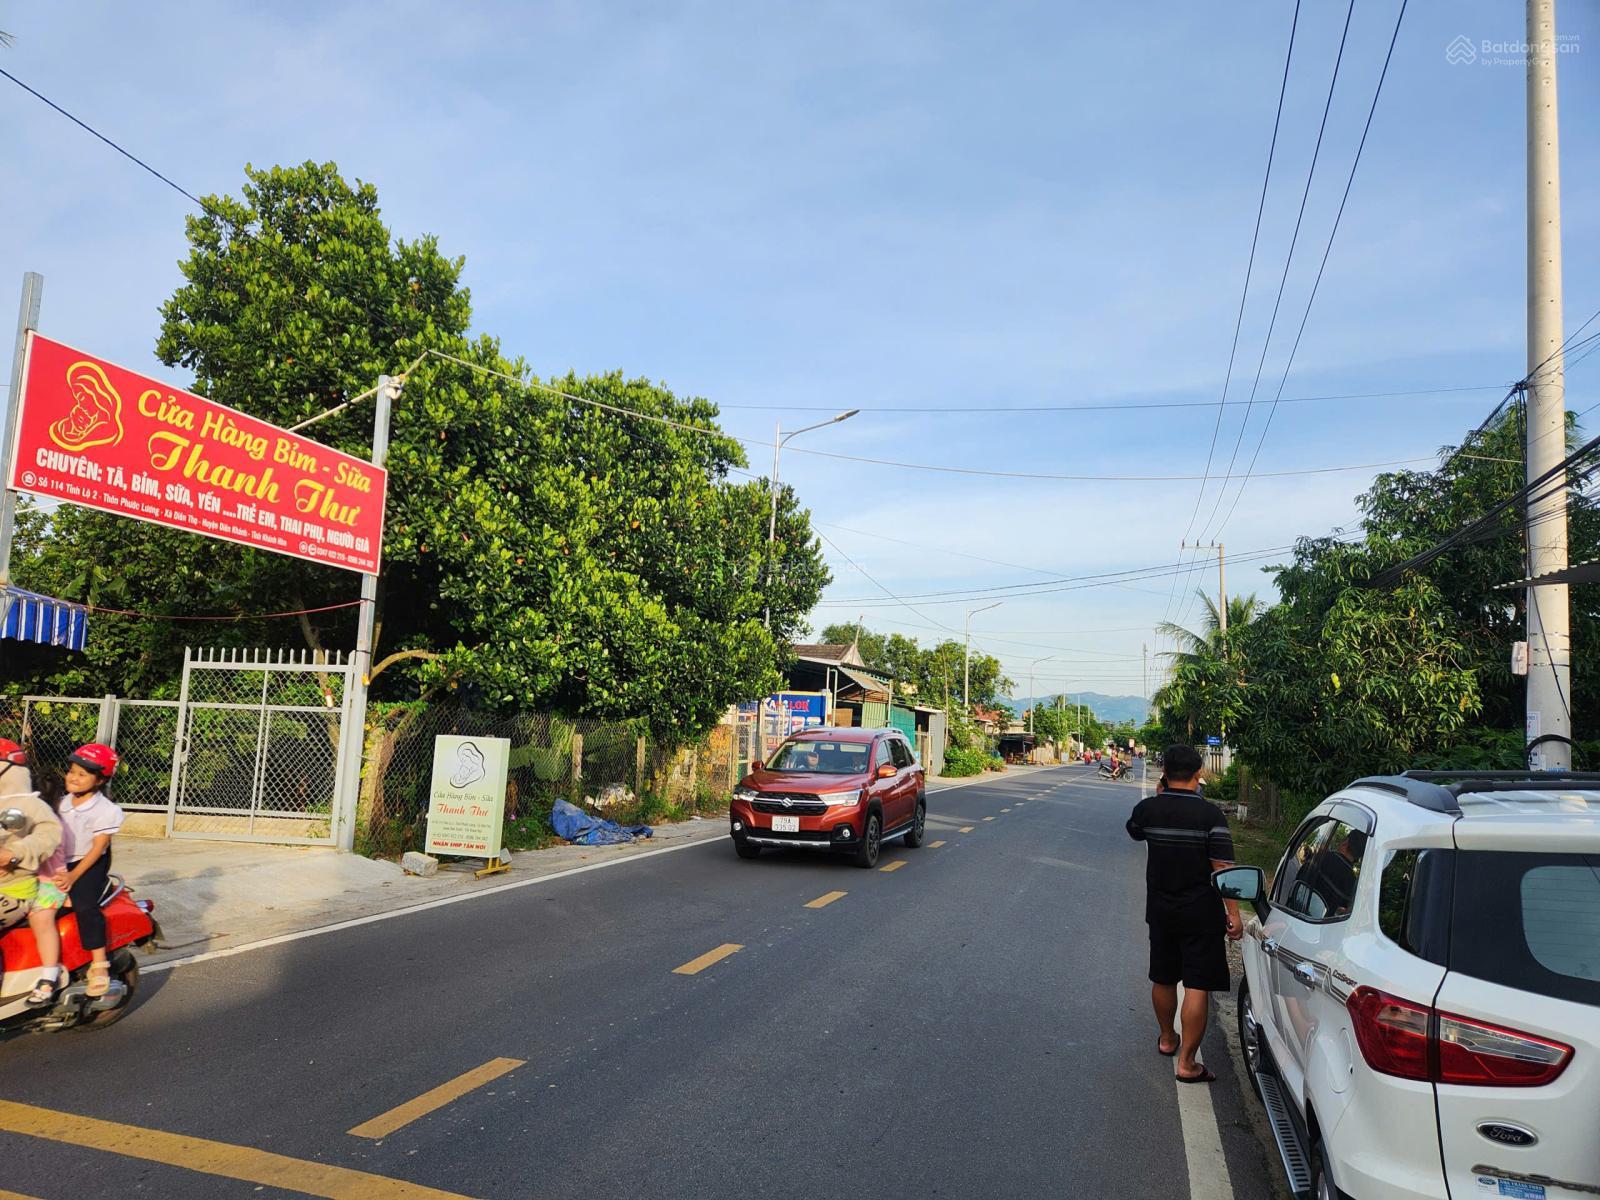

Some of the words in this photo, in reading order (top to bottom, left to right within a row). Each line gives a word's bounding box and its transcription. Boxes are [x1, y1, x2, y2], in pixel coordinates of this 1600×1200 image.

[138, 389, 194, 431] Cửa
[199, 410, 268, 460] Hàng
[273, 438, 317, 474] Bỉm
[333, 462, 371, 493] Sữa
[36, 447, 103, 482] CHUYÊN:
[106, 466, 128, 490] TÃ,
[131, 471, 161, 500] BỈM,
[165, 483, 194, 508] SỮA,
[198, 490, 221, 514] YẾN
[258, 509, 277, 530] EM,
[280, 515, 303, 535] THAI
[303, 522, 325, 543] PHỤ,
[327, 528, 355, 549] NGƯỜI
[355, 536, 370, 554] GIÀ
[37, 476, 48, 488] Số
[50, 480, 64, 491] 114
[82, 487, 91, 499] Lộ
[92, 490, 98, 499] 2
[148, 431, 280, 503] Thanh
[294, 478, 361, 527] Thư
[438, 803, 465, 815] Thanh
[1489, 1126, 1523, 1143] Ford
